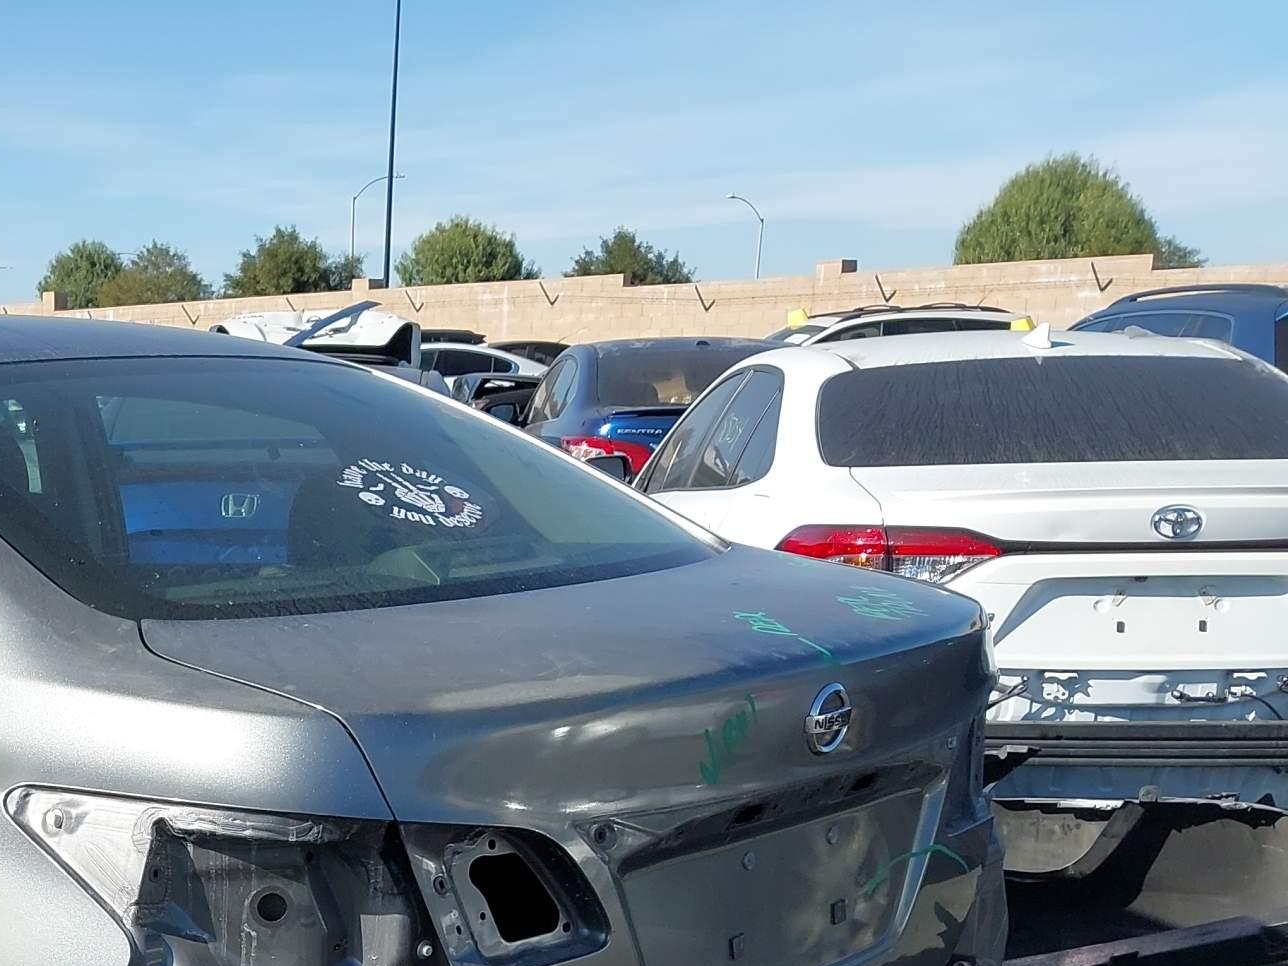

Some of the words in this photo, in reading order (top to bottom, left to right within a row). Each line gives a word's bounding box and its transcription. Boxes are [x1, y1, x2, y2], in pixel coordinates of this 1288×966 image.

[336, 465, 368, 488] have
[358, 458, 395, 472] the
[400, 463, 447, 484] day
[389, 505, 437, 526] you
[434, 501, 483, 528] deserve
